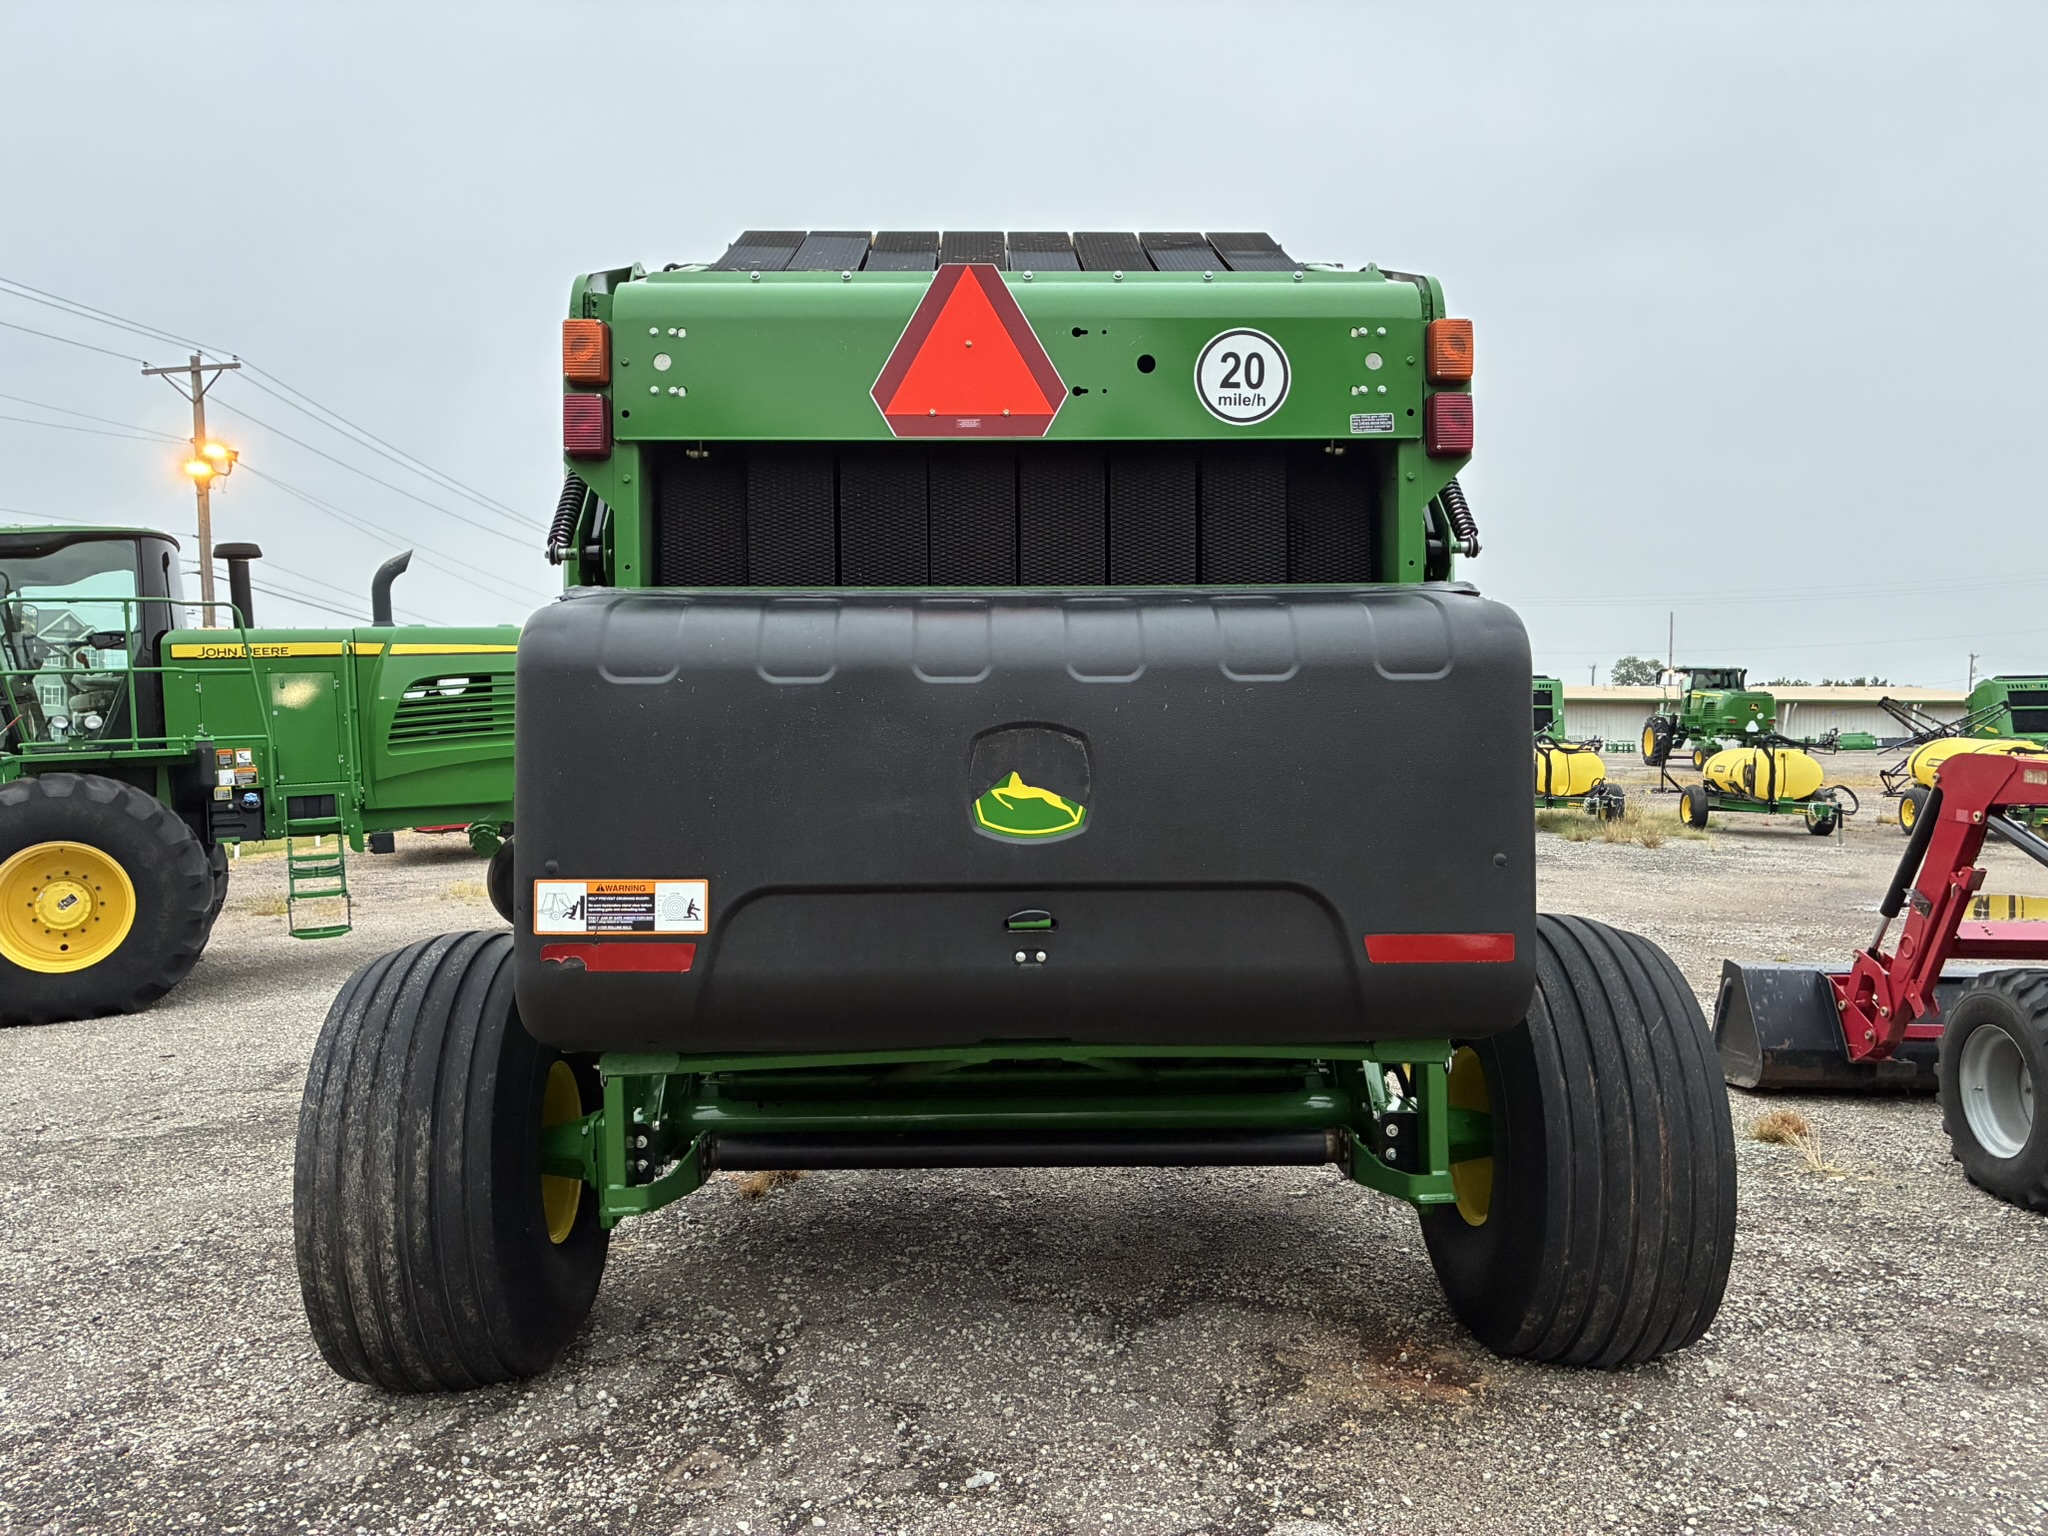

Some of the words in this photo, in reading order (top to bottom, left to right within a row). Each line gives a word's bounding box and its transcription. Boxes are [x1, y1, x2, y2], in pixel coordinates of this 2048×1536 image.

[1219, 351, 1265, 390] 20
[1218, 393, 1266, 406] mile/h
[197, 646, 238, 657] JOHN
